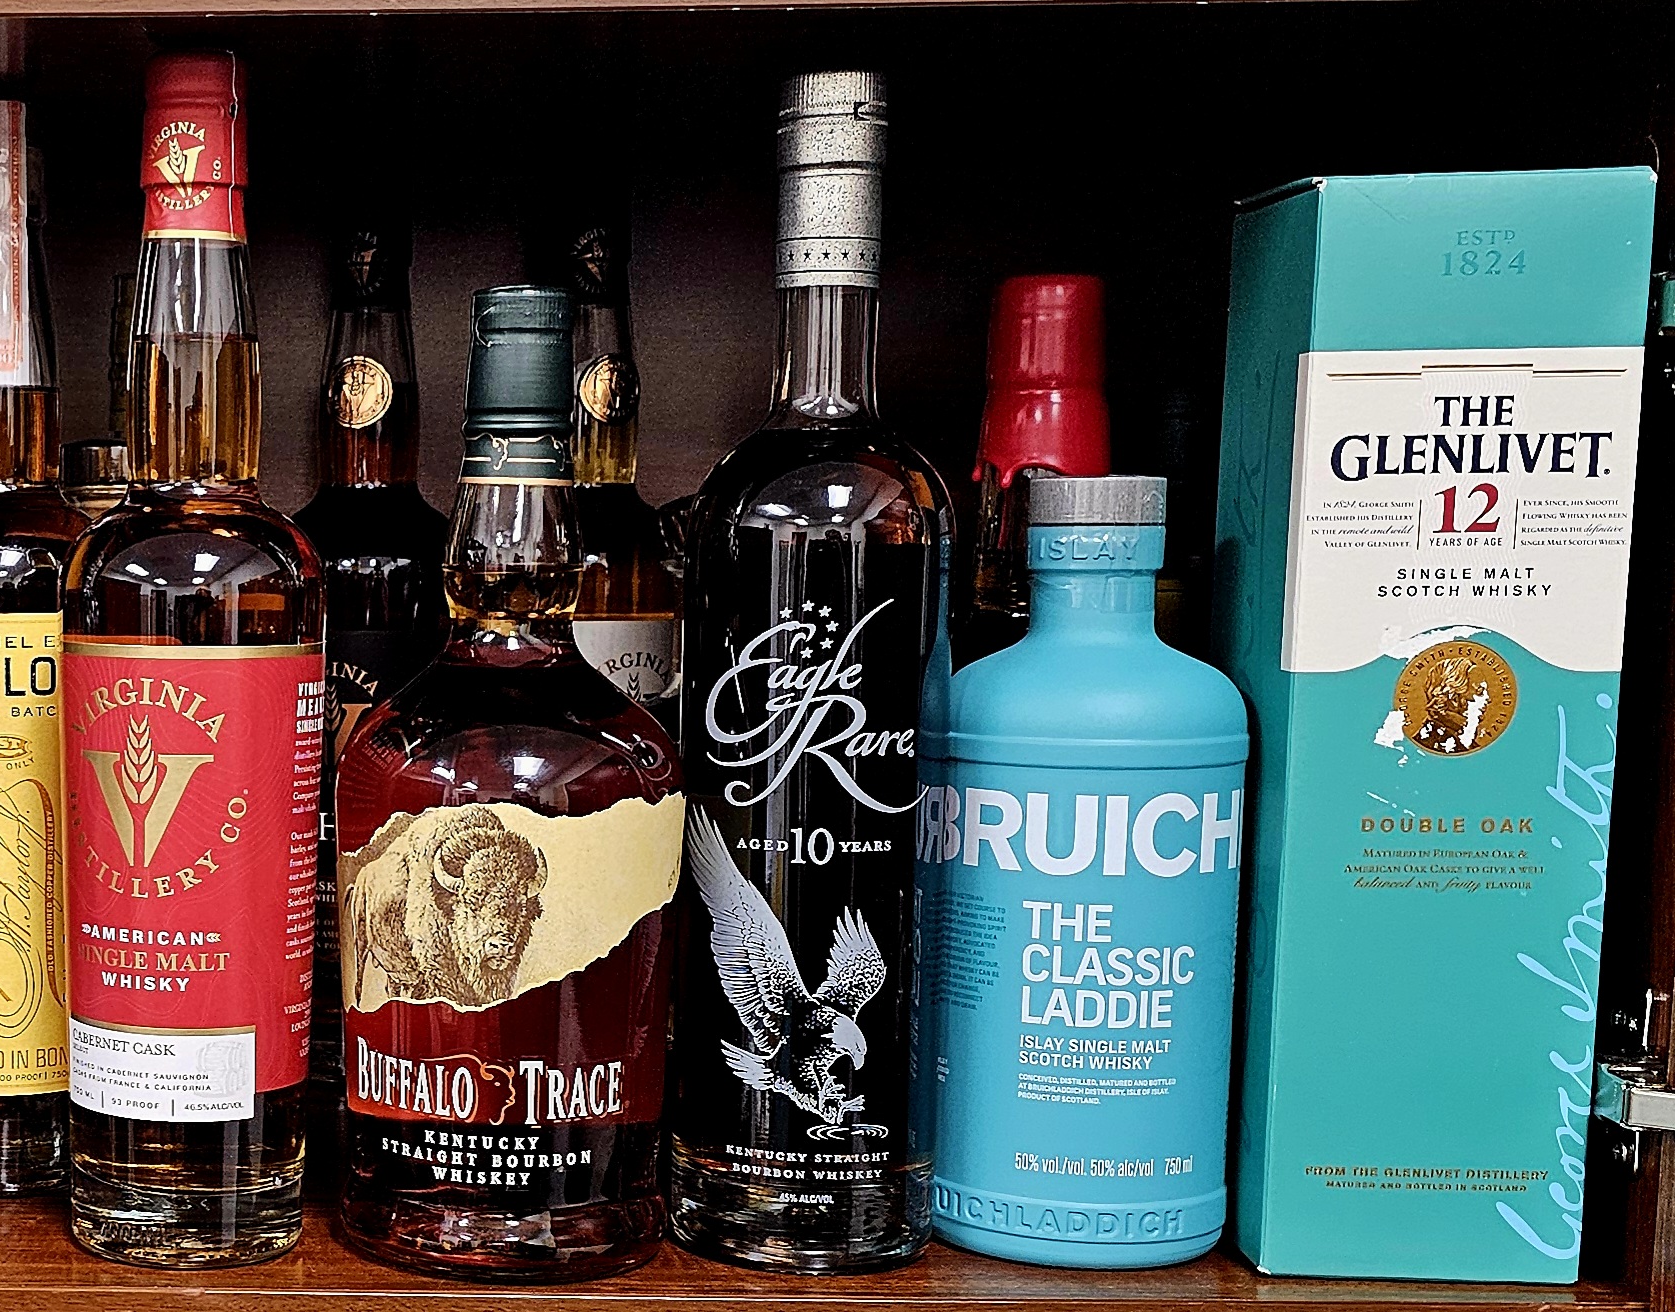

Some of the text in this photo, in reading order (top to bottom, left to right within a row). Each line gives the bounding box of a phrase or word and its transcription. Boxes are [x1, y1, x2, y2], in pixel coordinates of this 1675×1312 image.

[148, 122, 206, 159] VIRGINIA
[1441, 249, 1527, 276] 1824
[1434, 395, 1514, 427] THE
[1432, 482, 1501, 534] 12
[1584, 523, 1623, 536] definitive
[1039, 534, 1141, 562] ISLAY
[1429, 537, 1502, 547] YEARS OF AGE
[1396, 567, 1535, 580] SINGLE MALT
[1377, 584, 1552, 597] SCOTCH WHISKY
[597, 652, 668, 676] RGINI
[12, 706, 57, 717] BATC
[72, 678, 226, 743] VIRGINIA
[944, 784, 1244, 877] BRUICH
[1361, 818, 1533, 833] DOUBLE OAK
[736, 828, 892, 865] AGED 10 YEARS
[1353, 878, 1481, 893] balanced fruity
[1022, 900, 1114, 944] THE
[91, 925, 204, 946] AMERICAN
[156, 952, 230, 972] MALT
[1021, 943, 1196, 987] CLASSIC
[102, 972, 190, 992] WHISKY
[1020, 985, 1174, 1029] LADDIE
[73, 1028, 176, 1056] CABERNET CASK
[1019, 1034, 1171, 1054] ISLAY SINGLE MALT
[12, 1050, 28, 1068] IN
[37, 1047, 68, 1068] BON
[1019, 1051, 1153, 1070] SCOTCH WHISKY
[109, 1078, 140, 1088] FRANCE
[356, 1036, 623, 1124] BUFFALO TRACE
[126, 1100, 160, 1109] PROOF
[424, 1130, 540, 1151] KENTUCKY
[382, 1138, 592, 1168] STRAIGHT BOURBON
[726, 1145, 889, 1163] KENTUCKY STRAIGHT
[732, 1163, 883, 1181] BOURBON WHISKEY
[1015, 1152, 1154, 1178] 50% 50% alc/vol
[1305, 1166, 1548, 1181] FROM THE GLENLIVET DISTILLERY
[432, 1166, 530, 1186] WHISKEY
[934, 1185, 1184, 1238] UICHLADDICH
